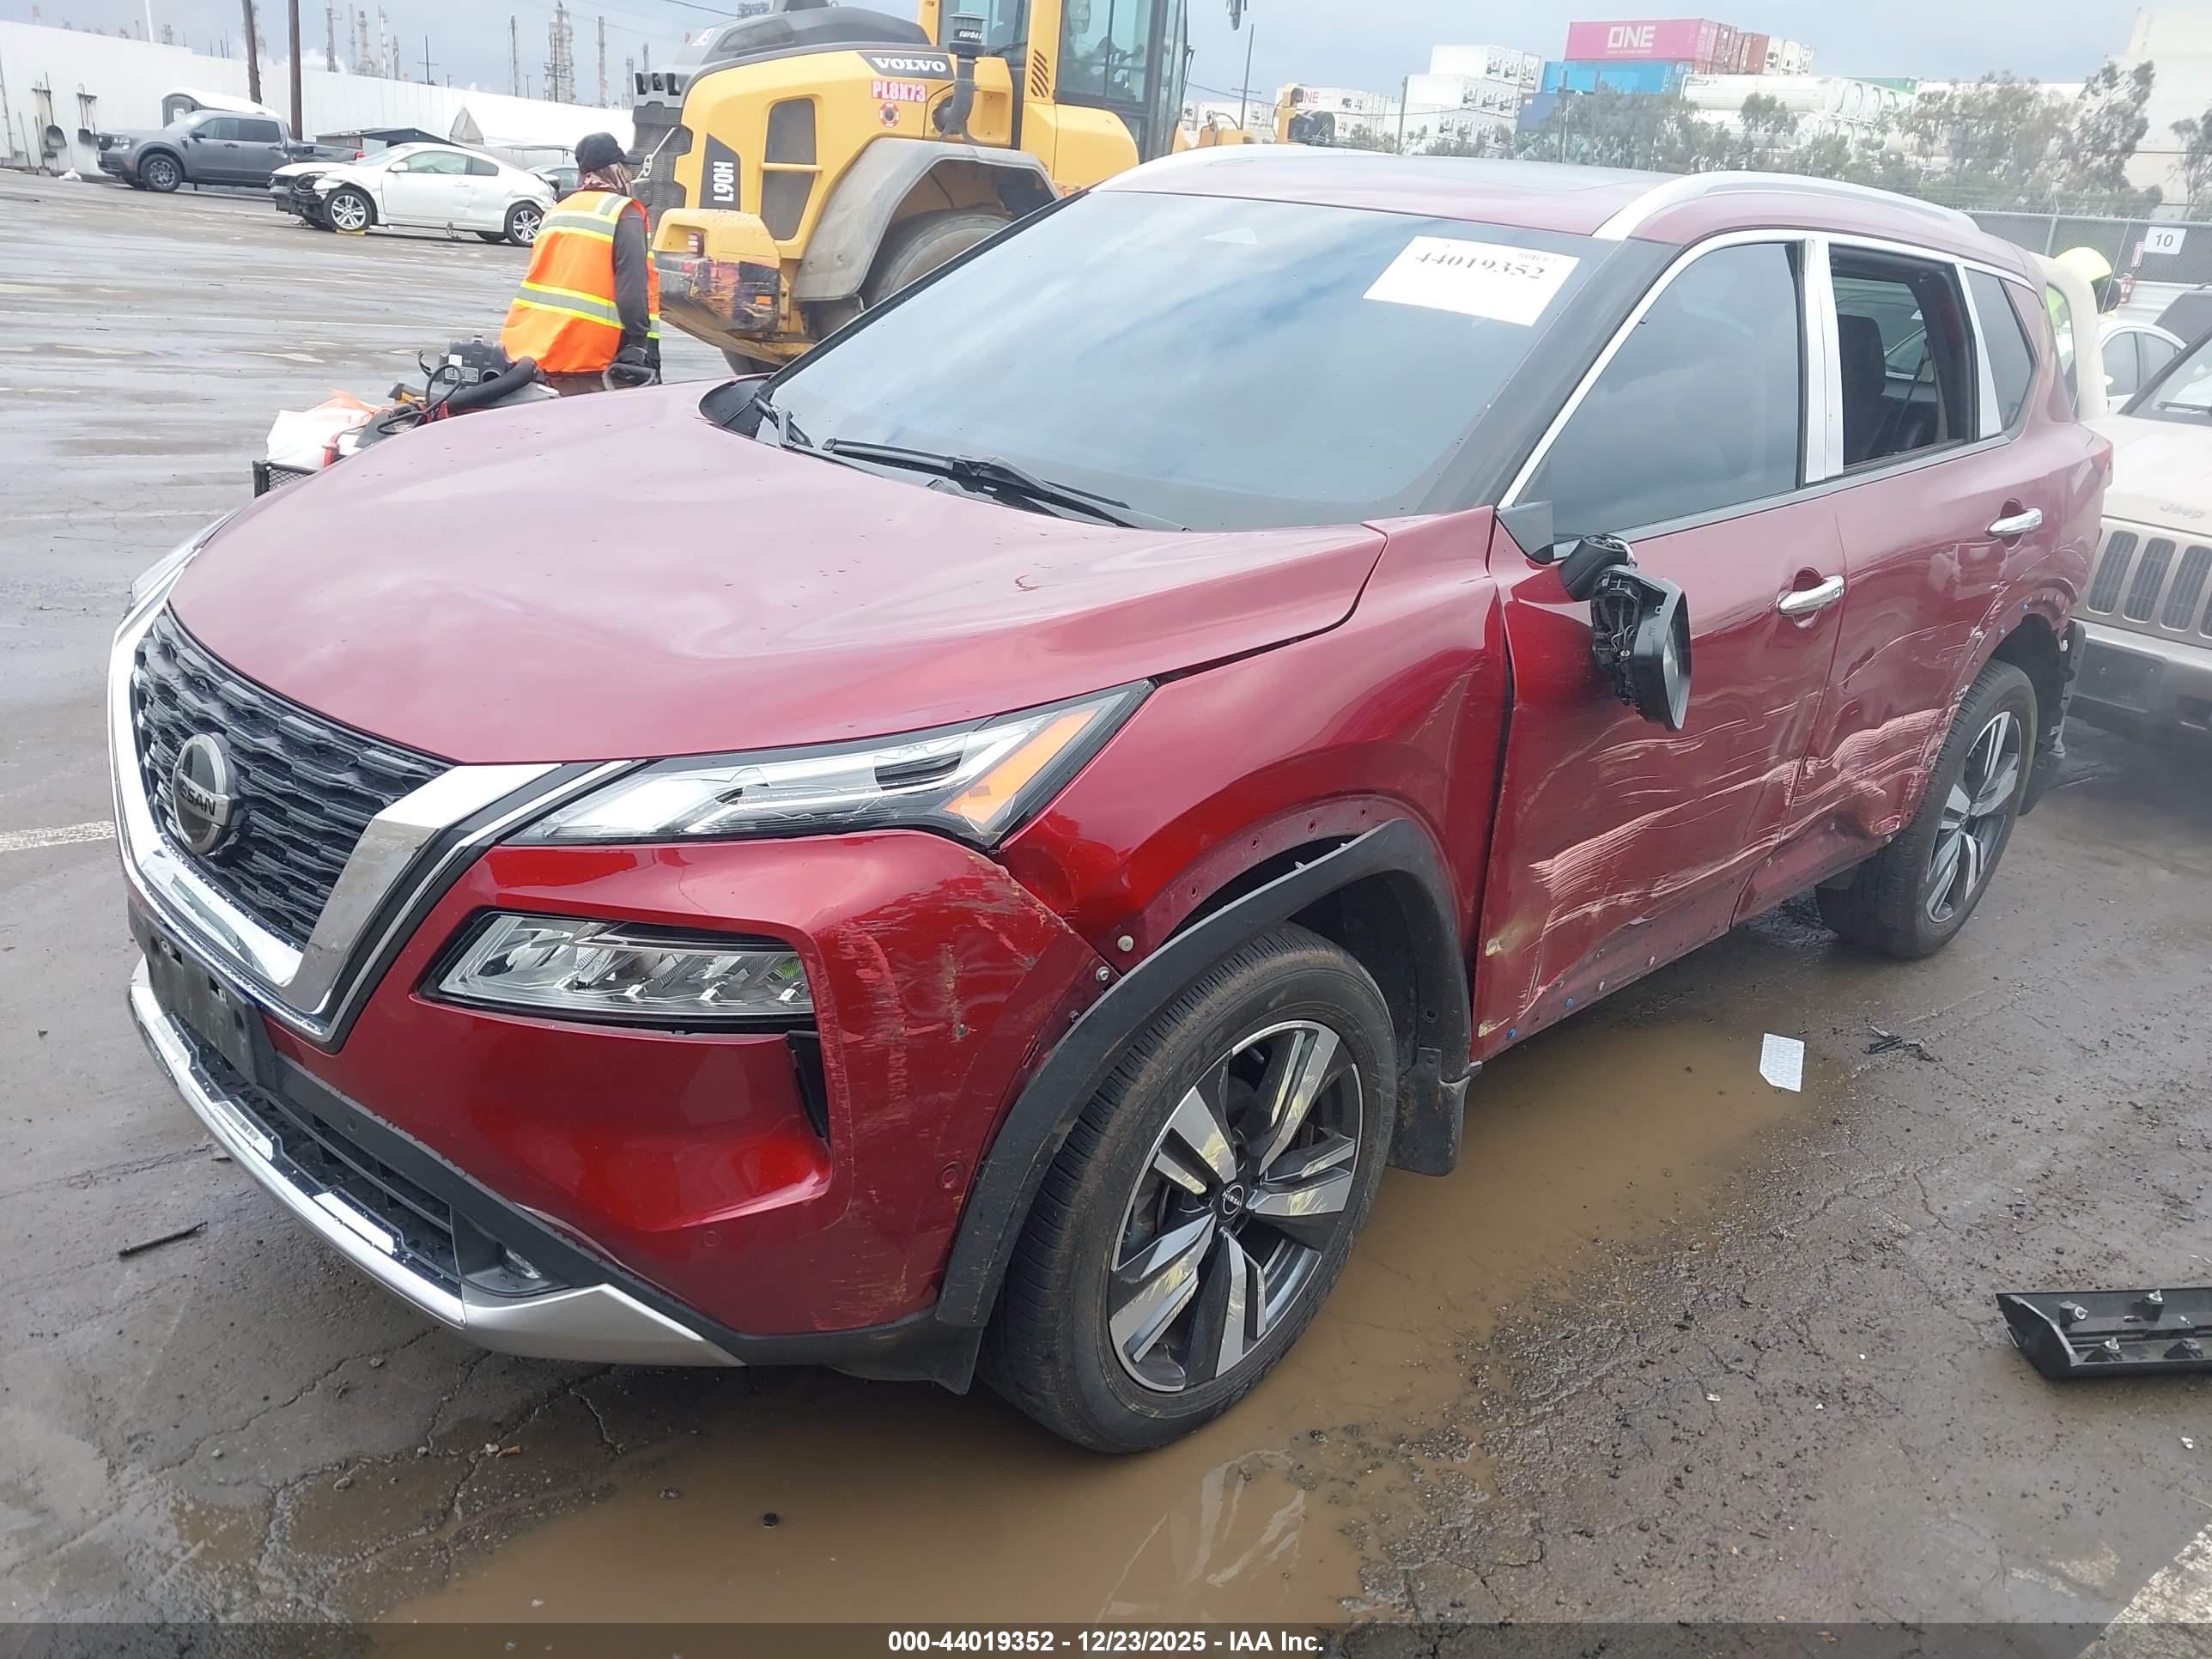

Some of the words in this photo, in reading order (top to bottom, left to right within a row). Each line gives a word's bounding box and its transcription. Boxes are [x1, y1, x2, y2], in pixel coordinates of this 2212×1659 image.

[1607, 25, 1656, 48] ONE
[872, 57, 946, 72] VOLVO
[713, 161, 734, 202] L90H
[2156, 233, 2174, 247] 10
[1415, 252, 1546, 279] 44019352
[2158, 503, 2205, 520] Jeep
